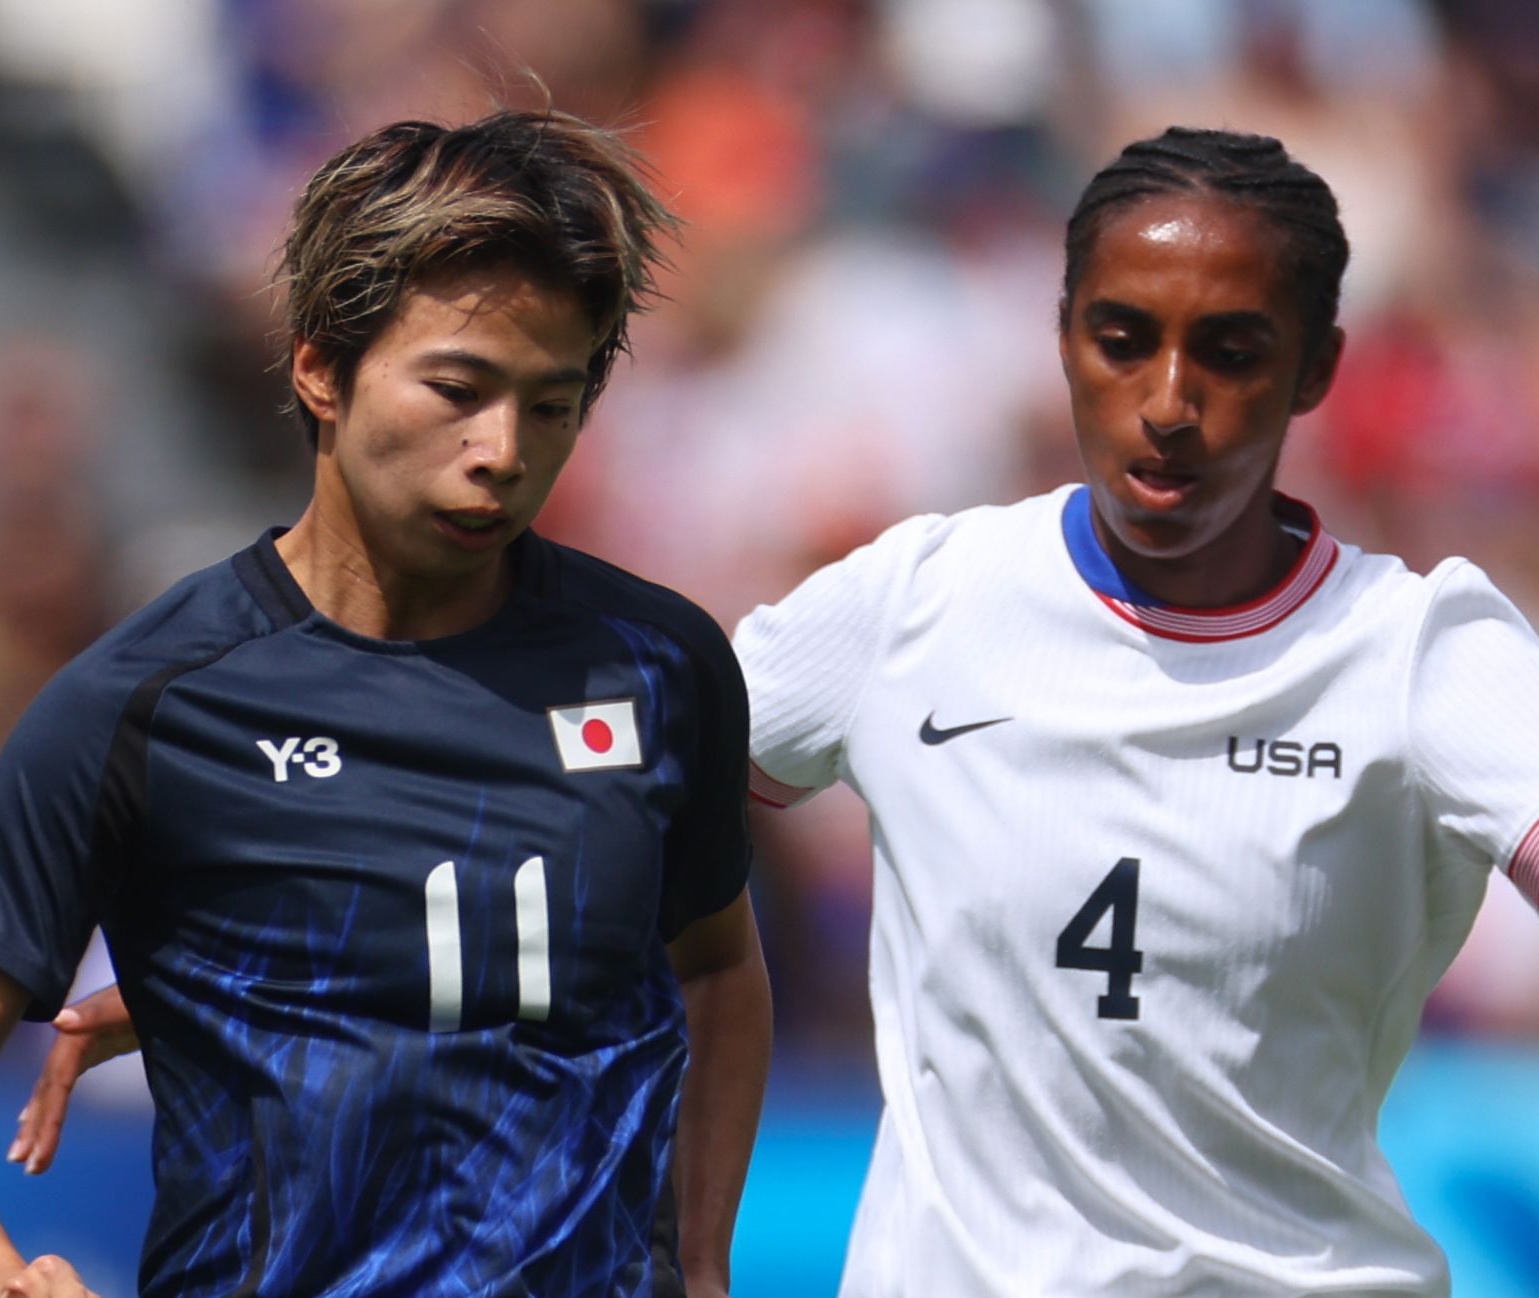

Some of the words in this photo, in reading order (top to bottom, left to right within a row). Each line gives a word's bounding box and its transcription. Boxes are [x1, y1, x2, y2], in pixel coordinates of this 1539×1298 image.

[256, 737, 342, 782] Y-3
[1227, 736, 1342, 779] USA
[425, 856, 551, 1033] 11
[1055, 857, 1143, 1021] 4
